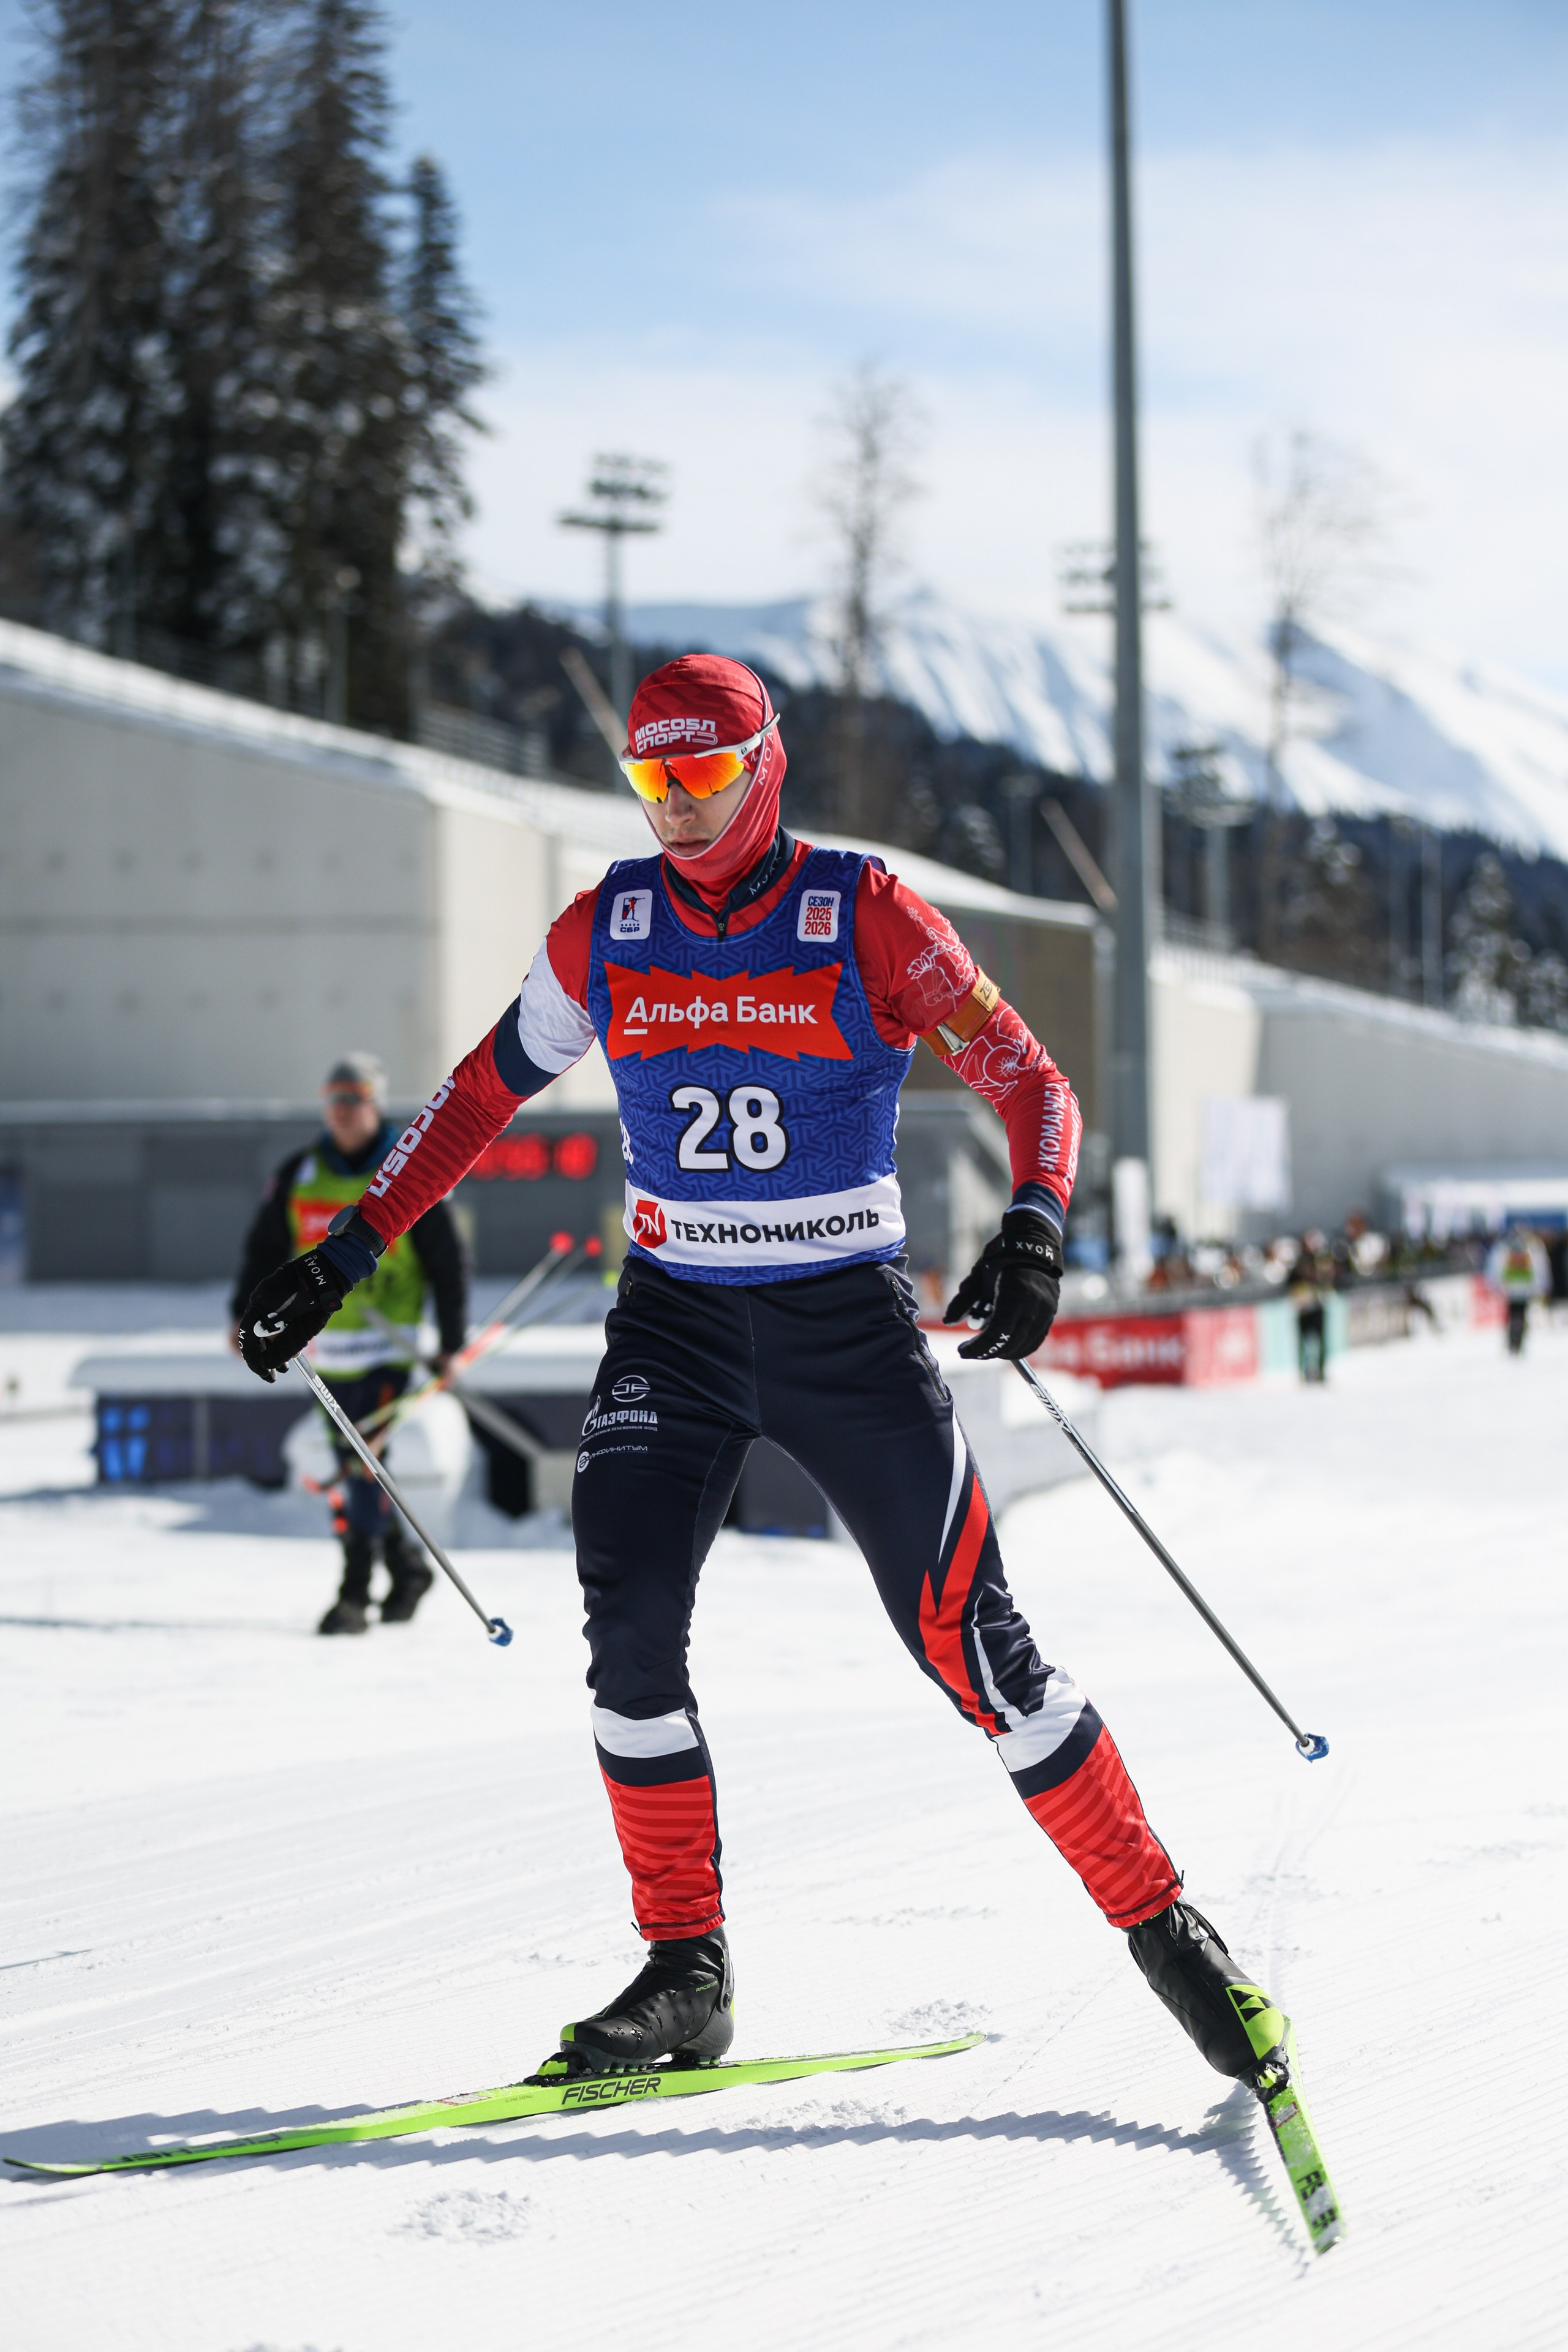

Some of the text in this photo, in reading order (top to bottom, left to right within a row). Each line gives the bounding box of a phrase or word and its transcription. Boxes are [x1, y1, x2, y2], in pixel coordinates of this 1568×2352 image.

[635, 718, 715, 742] МОСОБЛ
[636, 731, 693, 754] СПОРТ
[758, 718, 774, 786] MOA
[808, 895, 834, 907] СЕЗОН
[807, 907, 832, 921] 2025
[804, 922, 831, 935] 2026
[624, 996, 818, 1030] Альфа Банк
[669, 1084, 790, 1173] 28
[671, 1208, 879, 1244] ТЕХНОНИКОЛЬ
[1016, 1241, 1054, 1261] MOAX
[304, 1256, 326, 1286] MOAX
[597, 1410, 658, 1428] ГАЗФОНД
[589, 1446, 648, 1459] ИНФИНИТУМ
[561, 2076, 662, 2105] FISCHER
